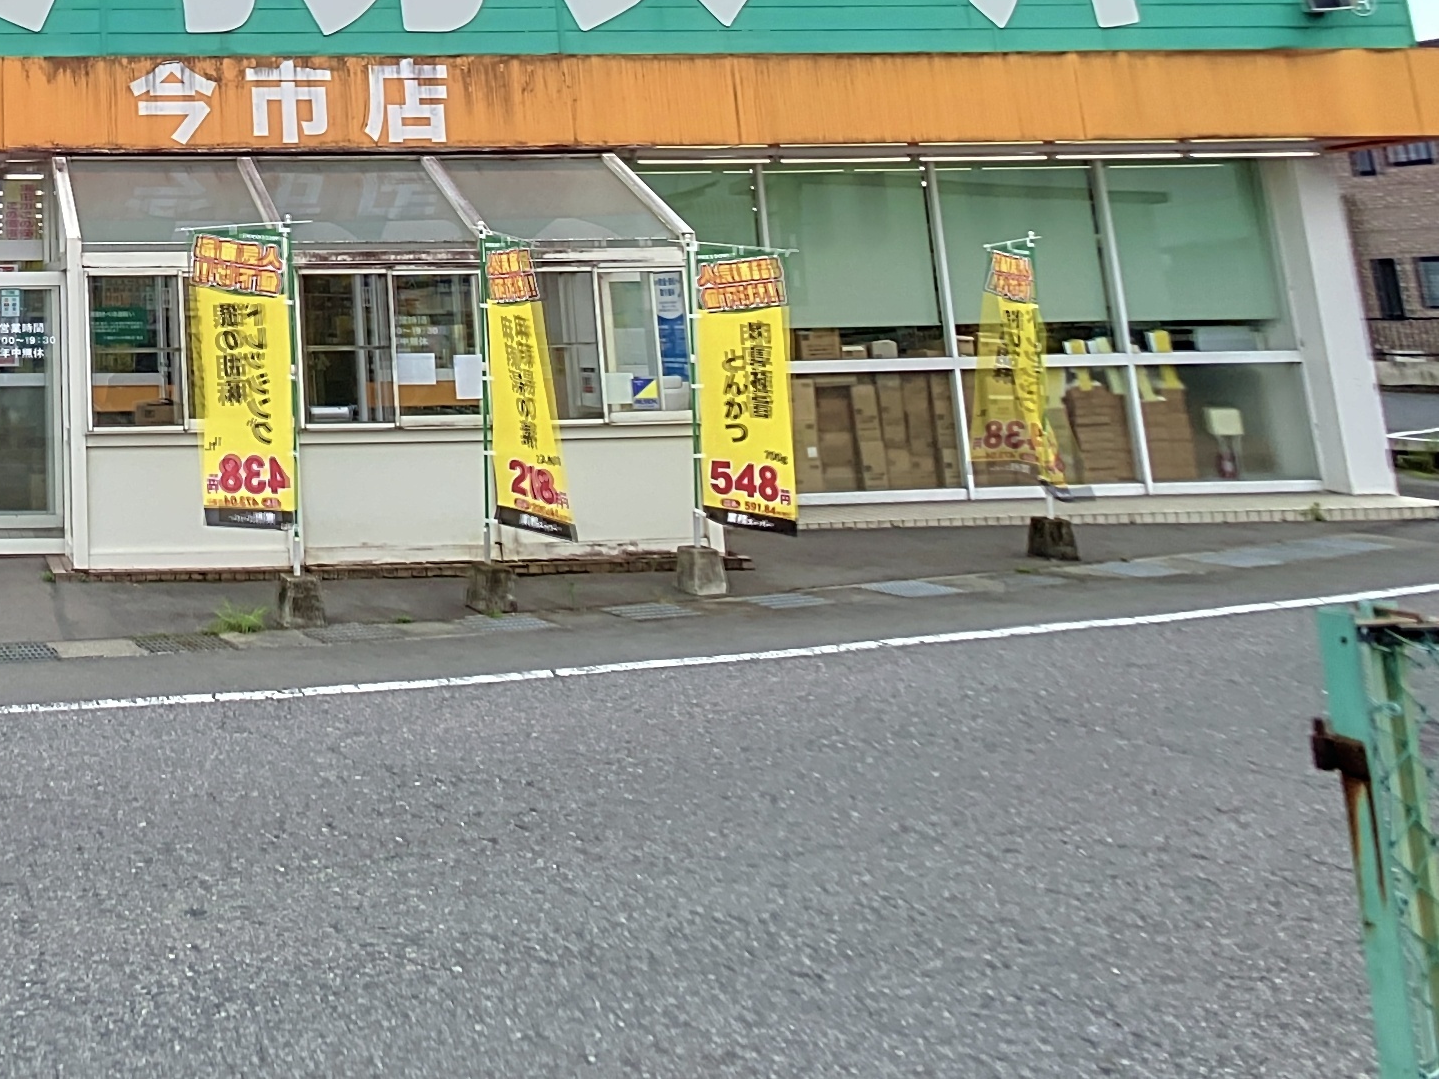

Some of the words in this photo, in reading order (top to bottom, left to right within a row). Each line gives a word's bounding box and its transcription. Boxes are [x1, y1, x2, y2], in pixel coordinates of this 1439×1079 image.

[129, 59, 449, 145] 今市店
[0, 323, 45, 334] 営業時間
[0, 348, 45, 359] 年中無休
